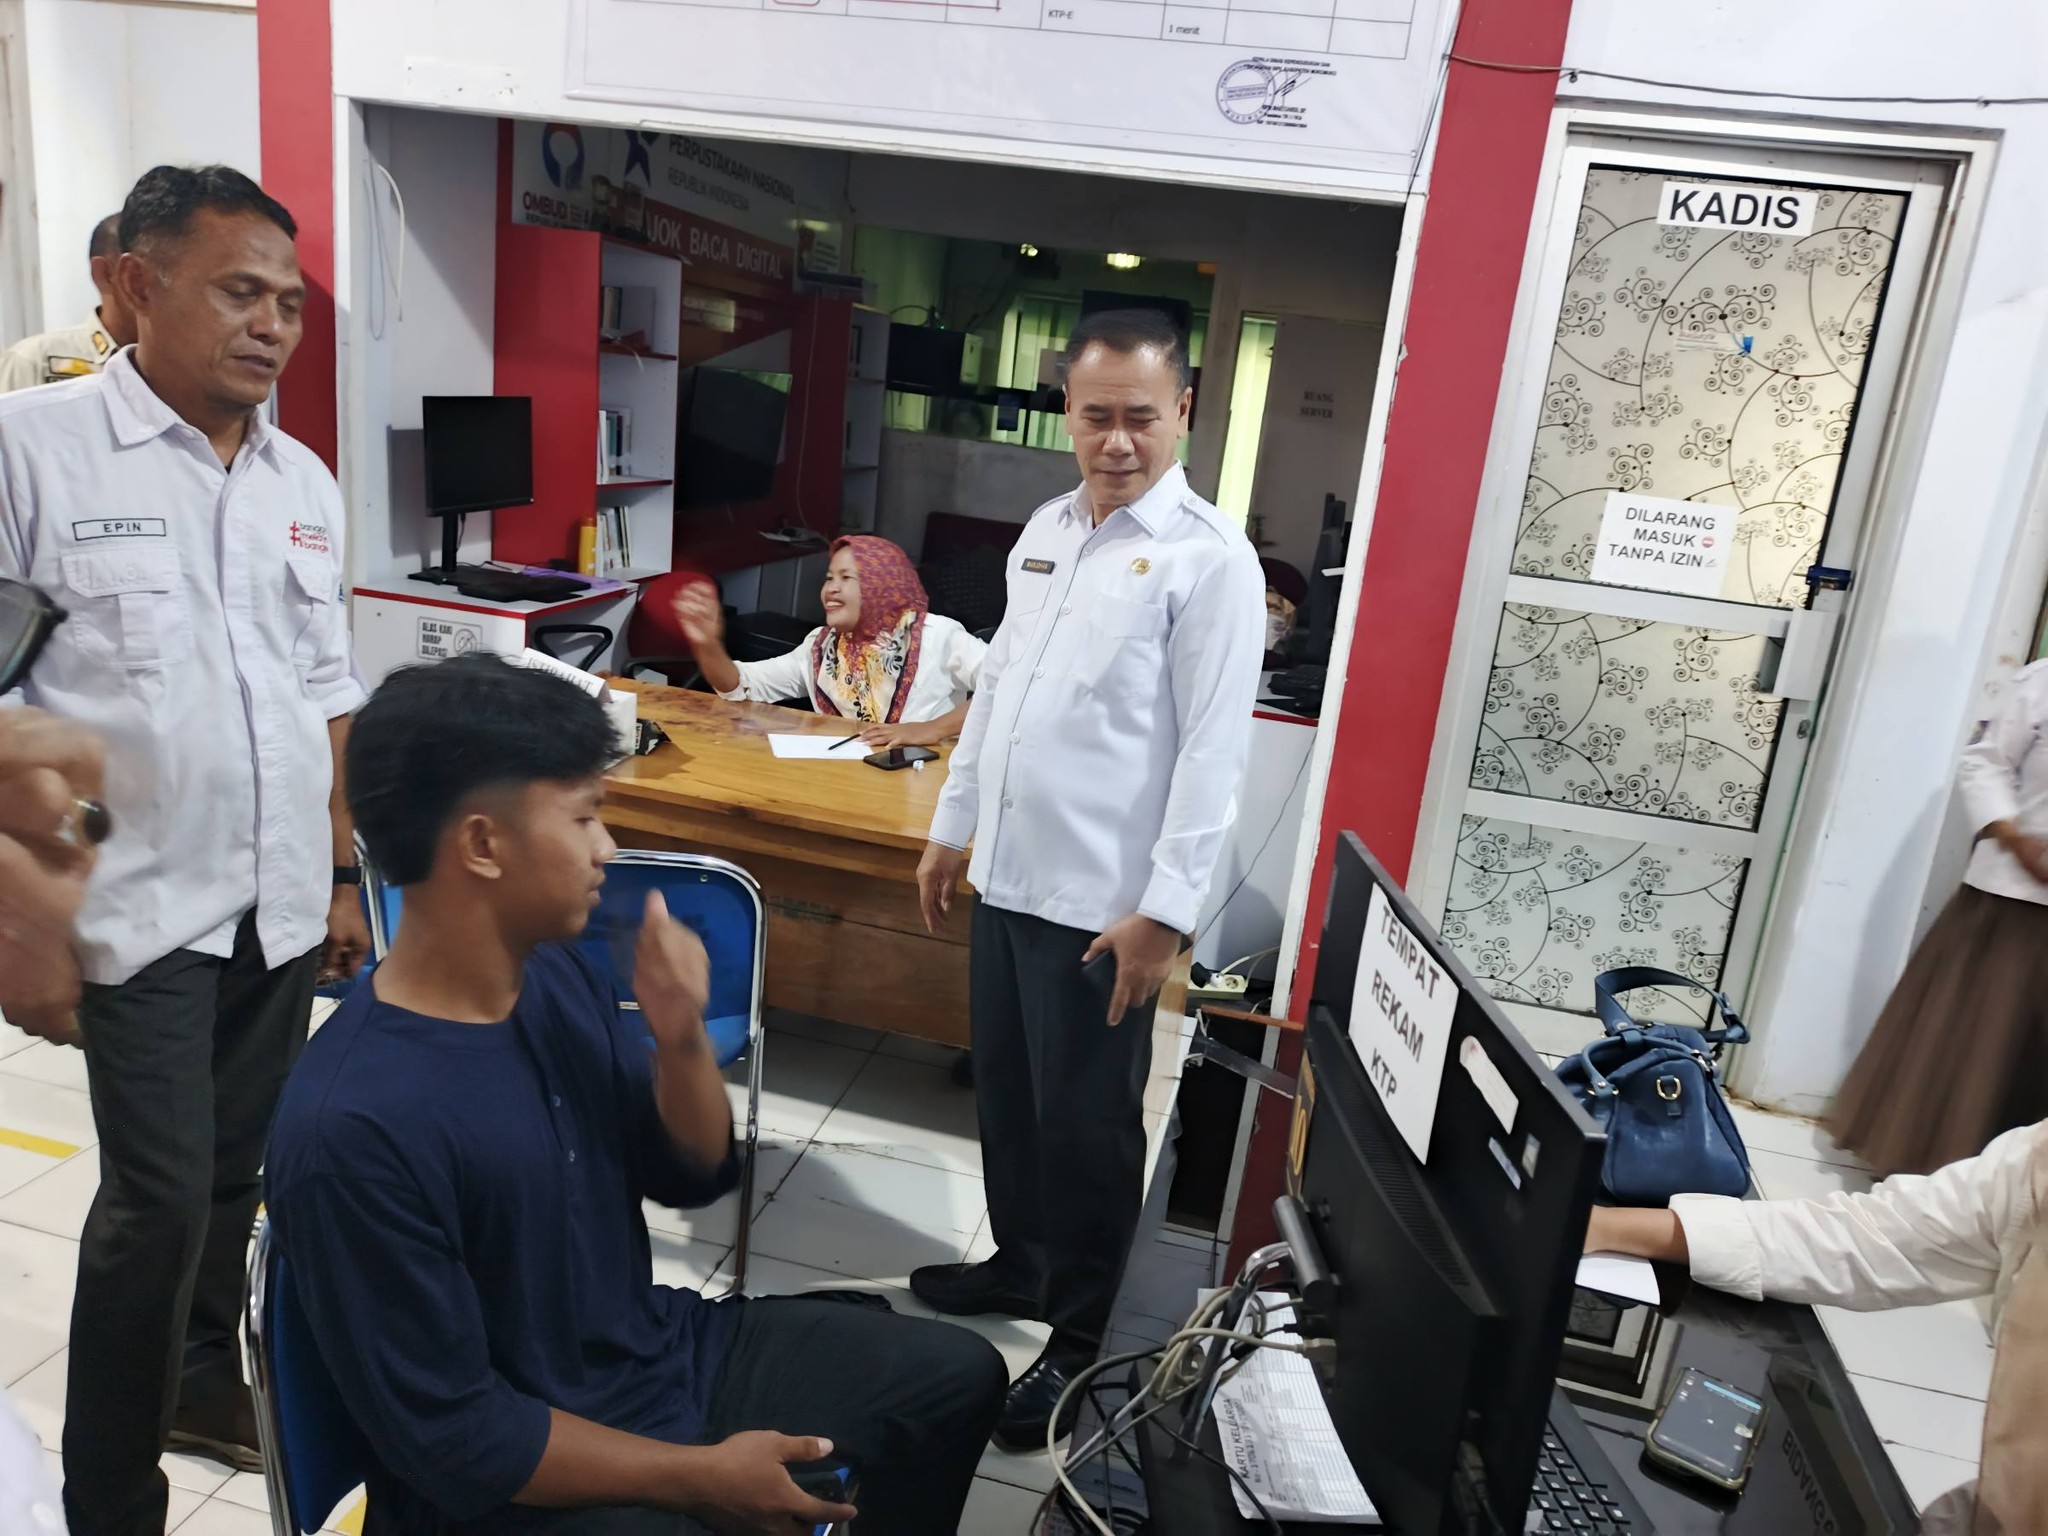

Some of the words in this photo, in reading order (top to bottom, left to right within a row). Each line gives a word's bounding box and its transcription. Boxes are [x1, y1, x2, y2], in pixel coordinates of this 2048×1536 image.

[1048, 9, 1074, 19] KTP-E
[523, 191, 567, 220] OMBUD
[1668, 189, 1800, 230] KADIS
[690, 227, 729, 265] BACA
[736, 242, 784, 280] DIGITAL
[103, 522, 142, 533] EPIN
[1625, 506, 1716, 531] DILARANG
[1633, 527, 1695, 549] MASUK
[1609, 543, 1665, 564] TANPA
[1670, 550, 1703, 568] IZIN
[1380, 905, 1441, 999] TEMPAT
[1371, 968, 1424, 1063] REKAM
[1370, 1047, 1398, 1099] KTP
[1236, 1445, 1250, 1479] KARTU
